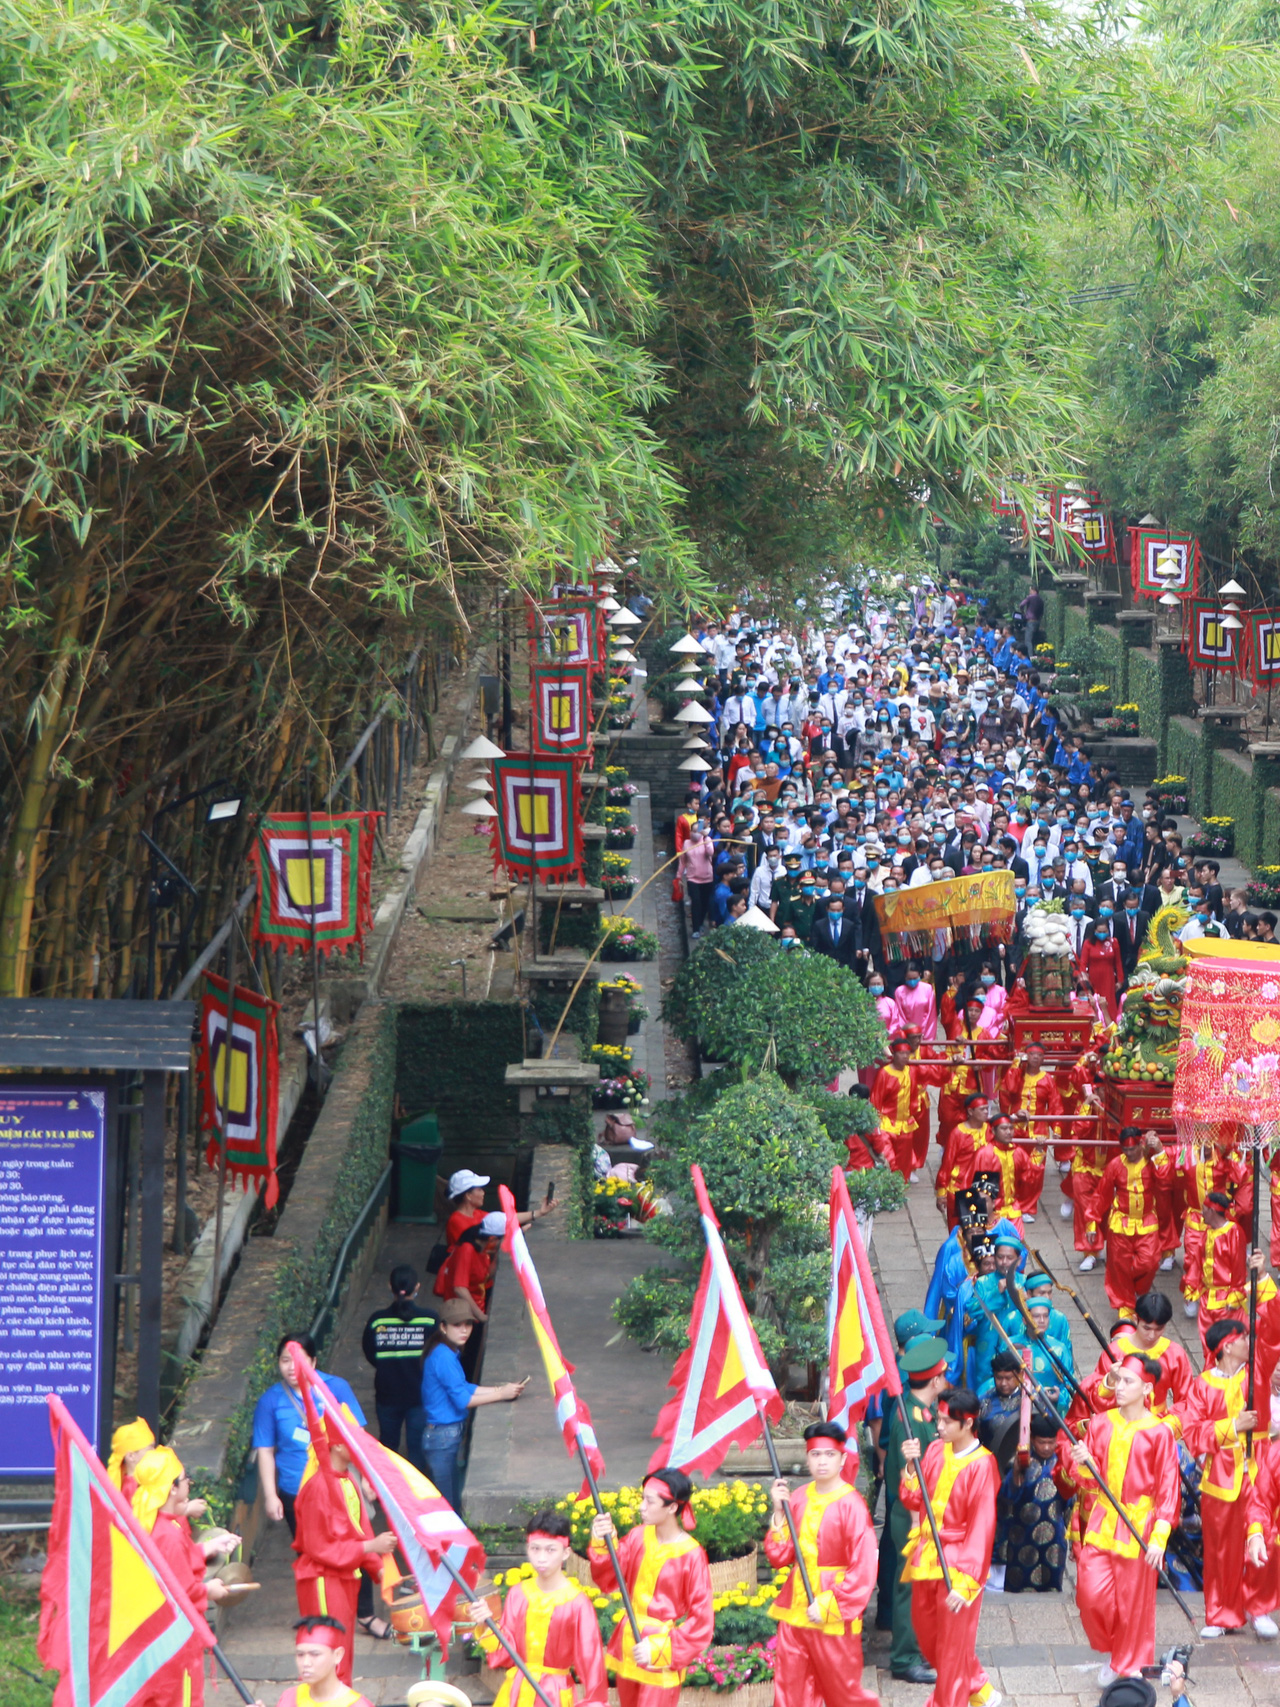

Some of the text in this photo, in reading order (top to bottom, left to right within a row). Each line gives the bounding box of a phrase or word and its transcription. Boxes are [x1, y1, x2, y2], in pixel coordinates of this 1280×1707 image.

[23, 1128, 44, 1139] CÁC
[45, 1130, 66, 1139] VUA
[67, 1128, 95, 1139] HÙNG
[3, 1159, 24, 1170] ngày
[25, 1160, 50, 1170] trong
[8, 1250, 33, 1259] trang
[60, 1249, 77, 1259] lịch
[75, 1260, 93, 1270] Việt
[39, 1273, 61, 1282] xung
[38, 1294, 67, 1304] không
[67, 1296, 93, 1305] mang
[28, 1305, 52, 1315] chụp
[6, 1363, 23, 1373] quy
[49, 1361, 64, 1370] khi
[35, 1384, 54, 1392] Ban
